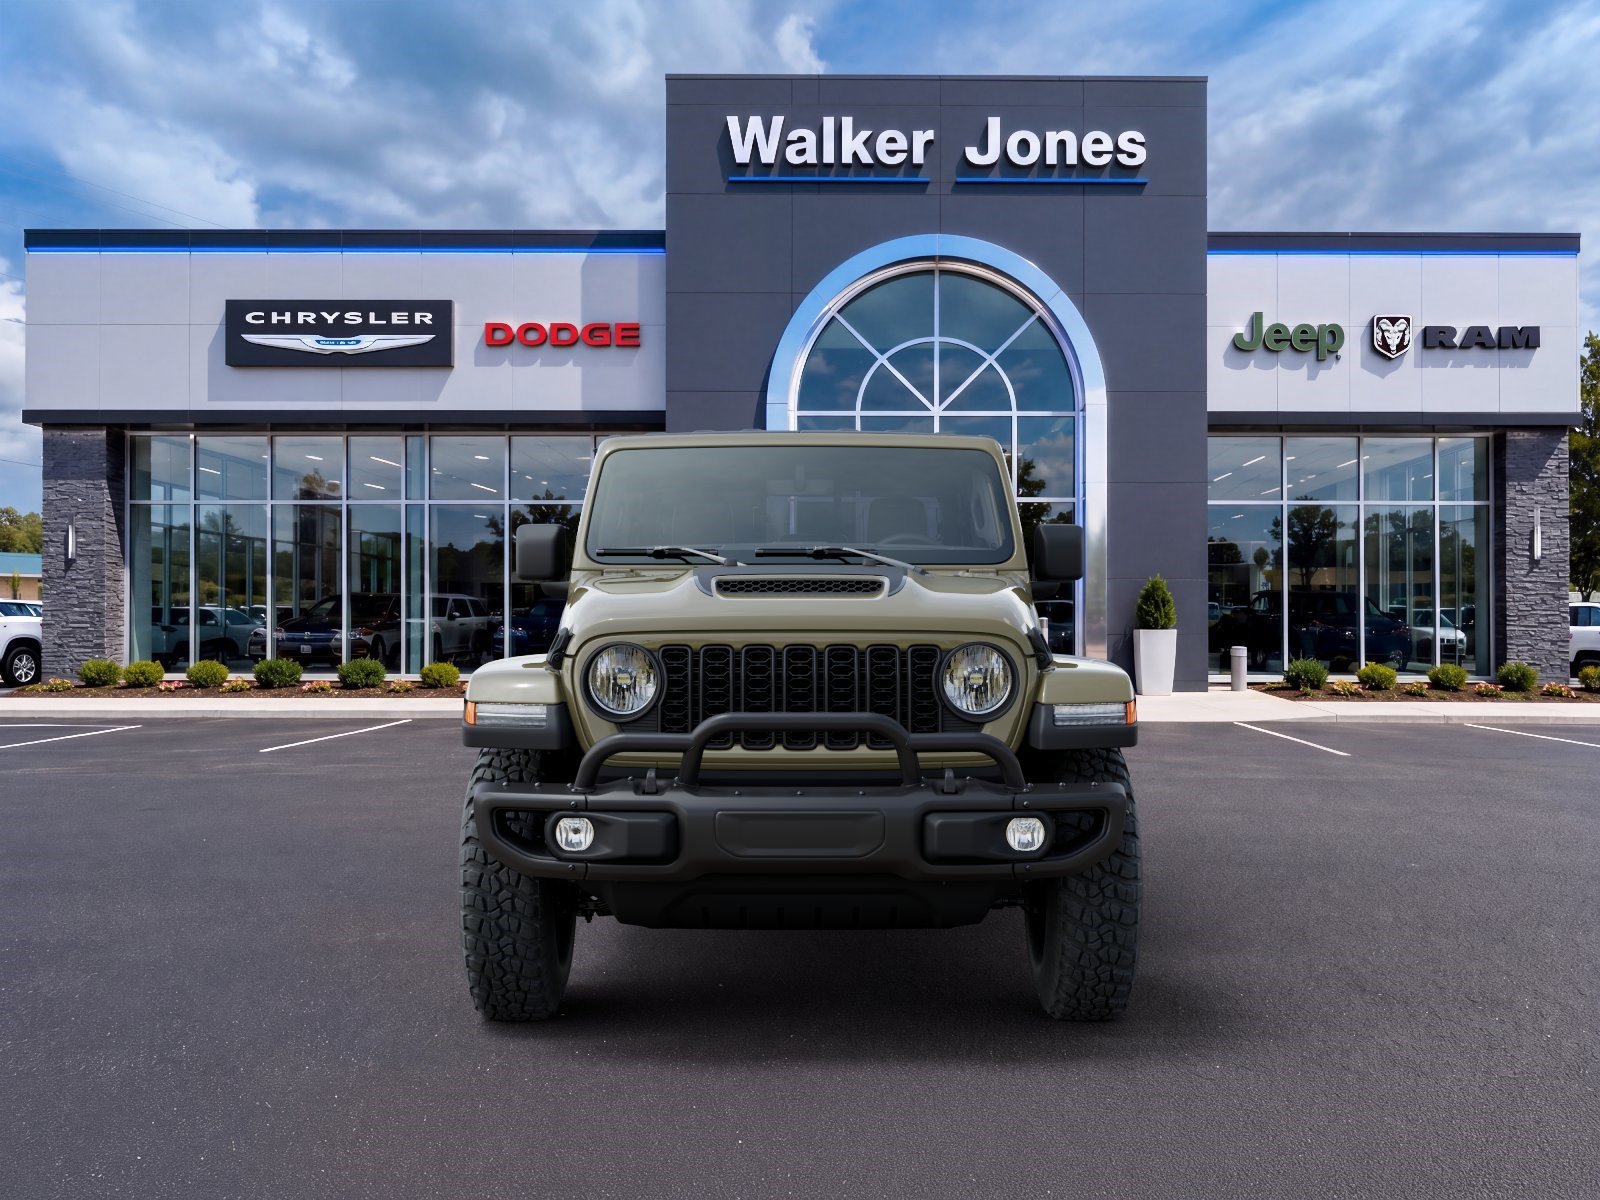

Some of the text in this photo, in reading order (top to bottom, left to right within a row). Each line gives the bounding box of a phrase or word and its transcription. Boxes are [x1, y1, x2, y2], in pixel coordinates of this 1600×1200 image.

[726, 115, 1148, 166] Walker Jones
[245, 311, 433, 325] CHRYSLER
[485, 322, 641, 348] DODGE
[1233, 311, 1345, 361] Jeep
[1422, 325, 1541, 349] RAM
